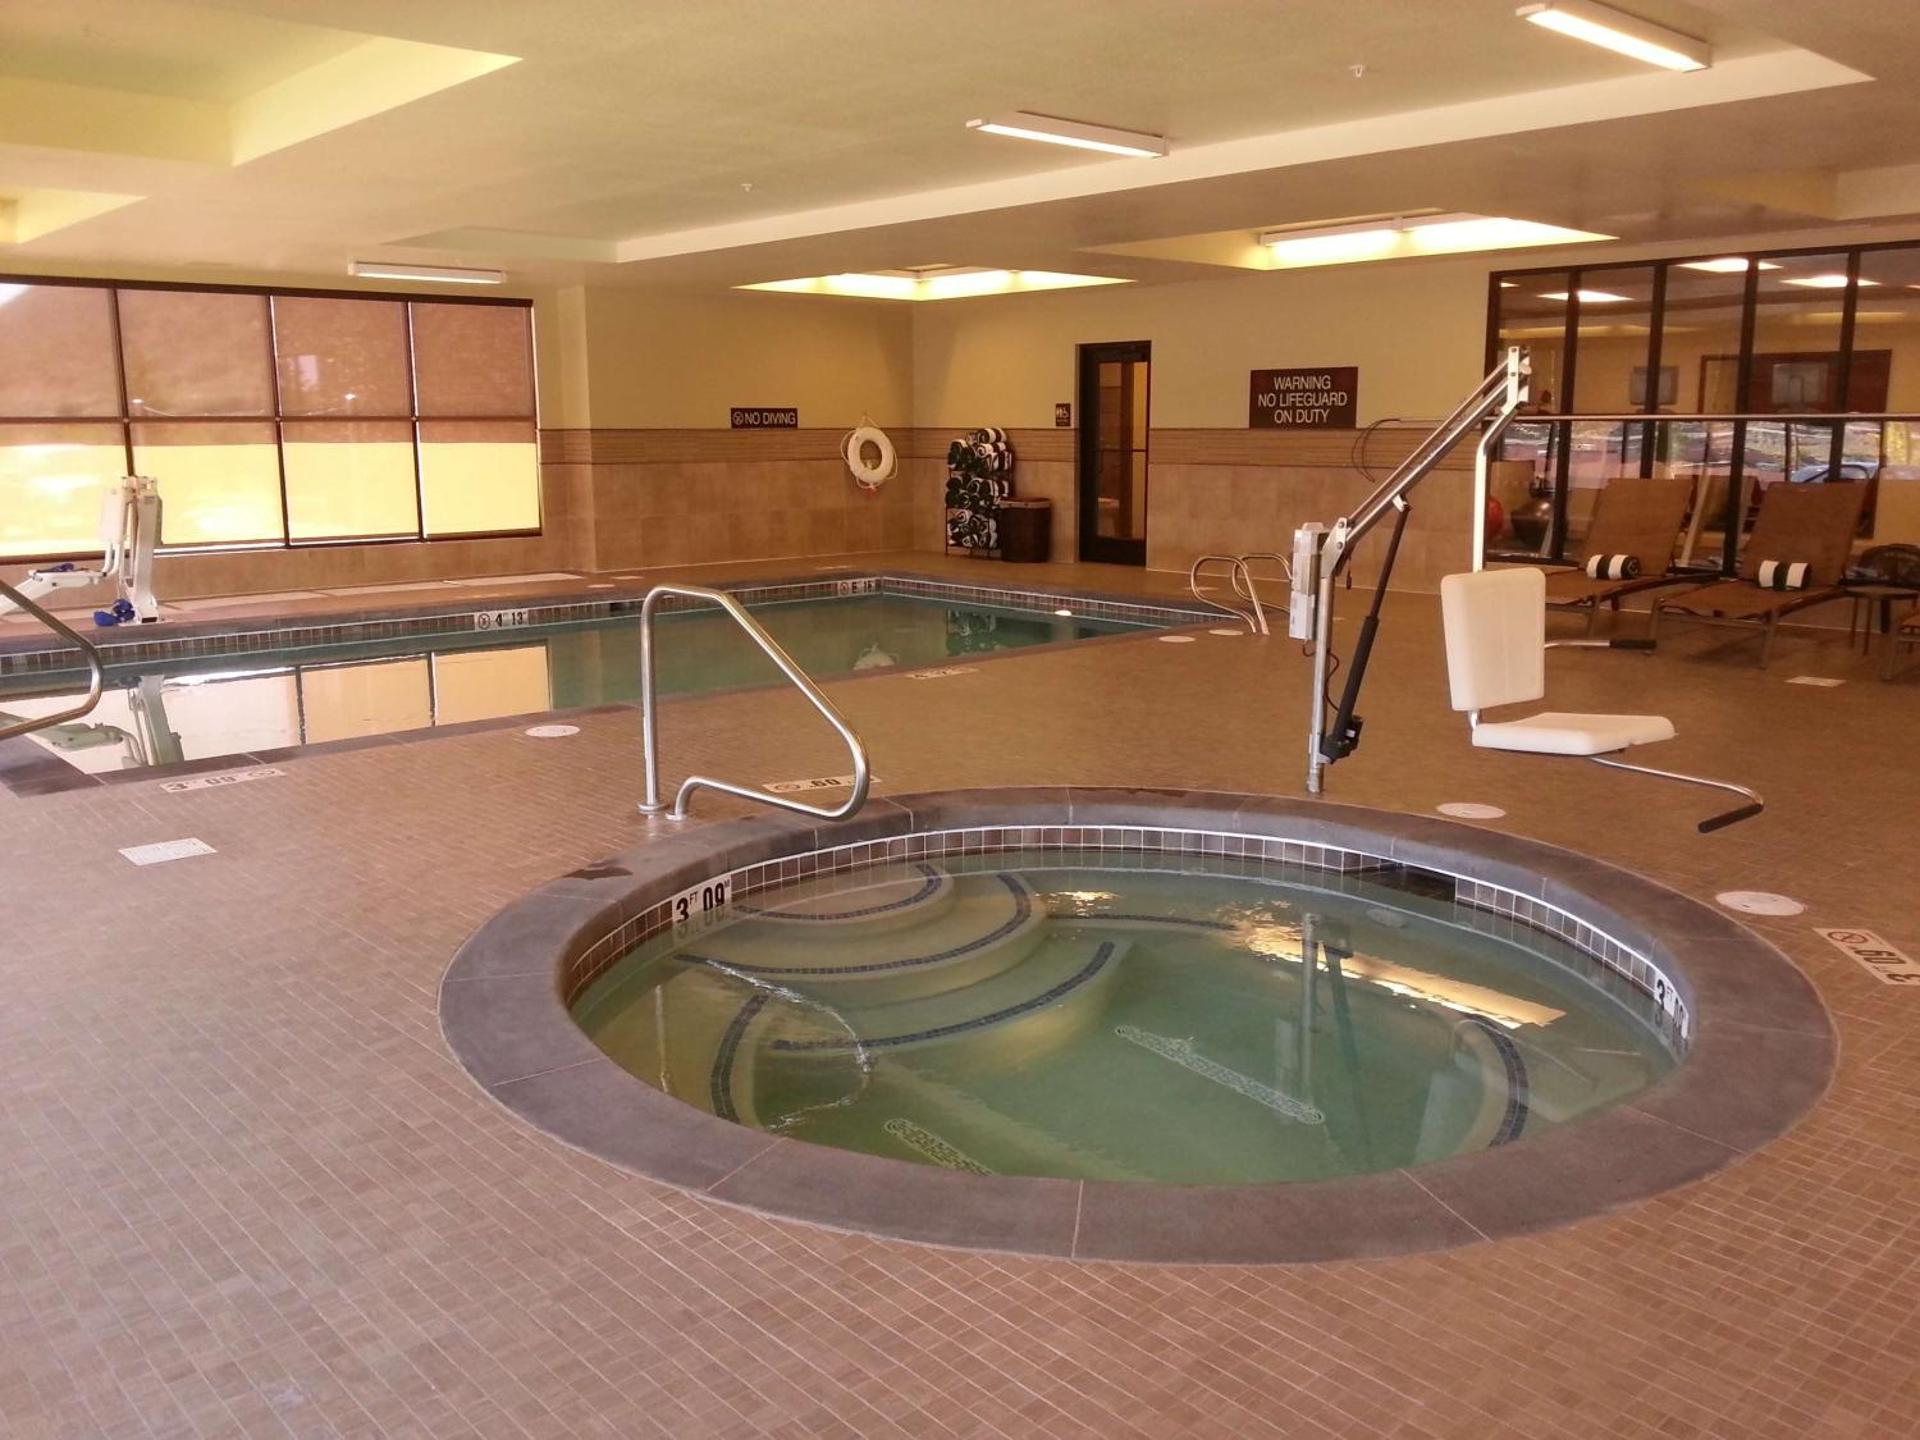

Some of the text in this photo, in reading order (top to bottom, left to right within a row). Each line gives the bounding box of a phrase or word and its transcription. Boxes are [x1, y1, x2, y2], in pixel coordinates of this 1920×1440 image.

[1274, 375, 1331, 390] WARNING
[1258, 392, 1348, 407] NO LIFEGUARD
[745, 412, 796, 425] NO DIVING
[1274, 408, 1330, 424] ON DUTY
